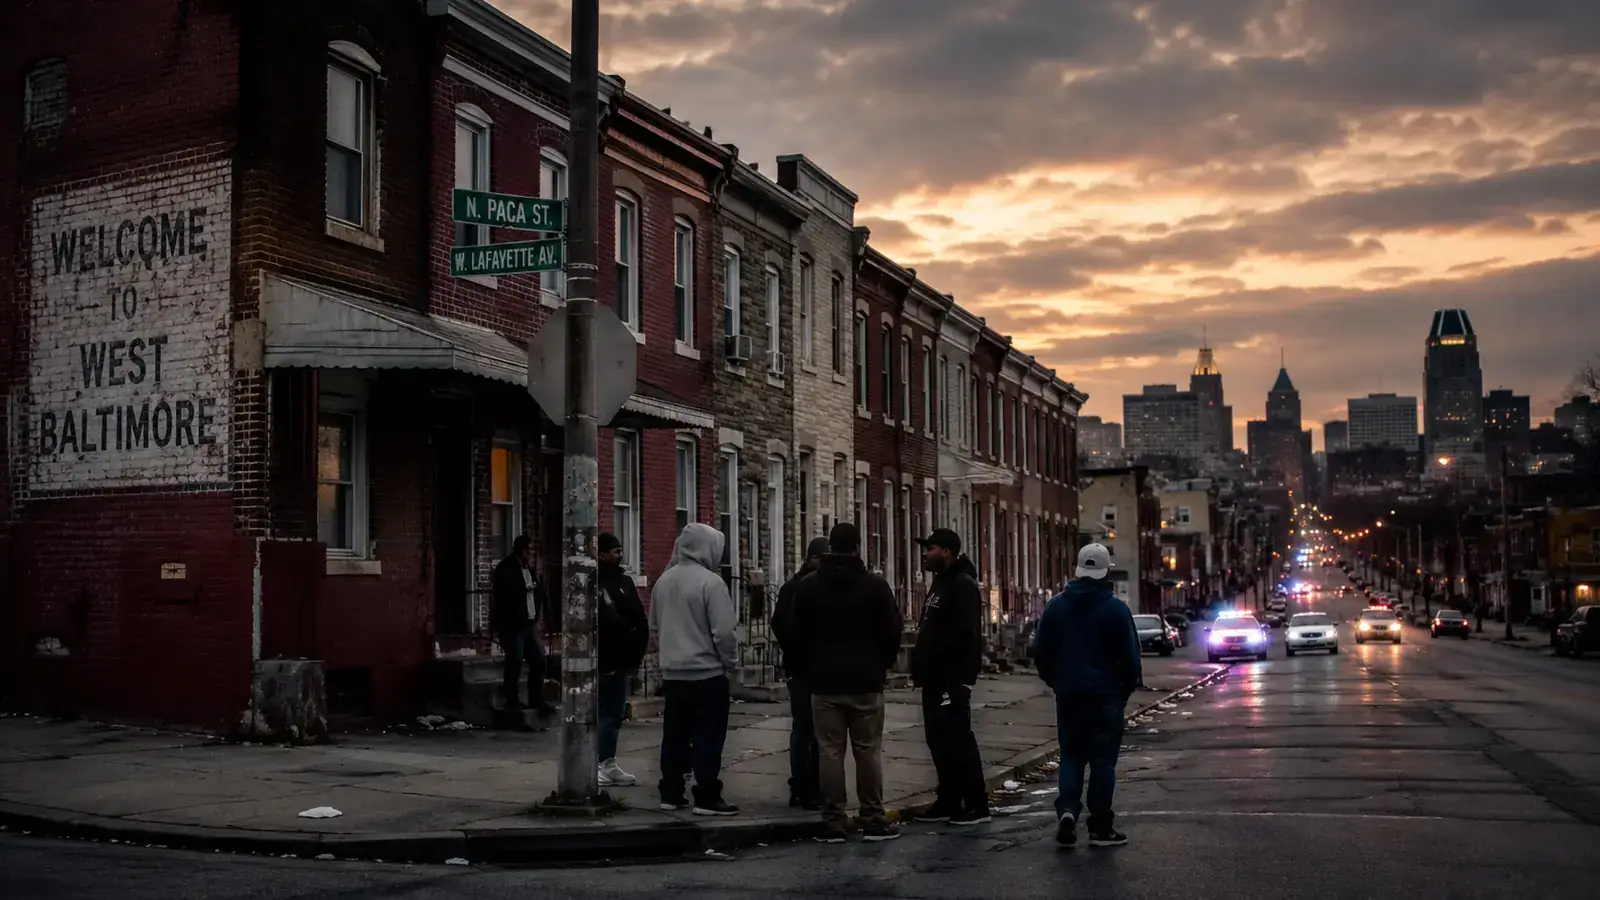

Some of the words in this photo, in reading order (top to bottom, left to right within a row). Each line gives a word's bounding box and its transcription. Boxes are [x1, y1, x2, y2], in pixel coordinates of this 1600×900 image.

[467, 196, 481, 218] N.
[487, 198, 526, 223] PACA
[532, 204, 553, 226] ST.
[51, 207, 207, 274] WELCOME
[455, 252, 468, 271] W.
[471, 247, 534, 271] LAFAYETTE
[107, 284, 138, 321] TO
[79, 335, 168, 389] WEST
[40, 399, 217, 454] BALTIMORE
